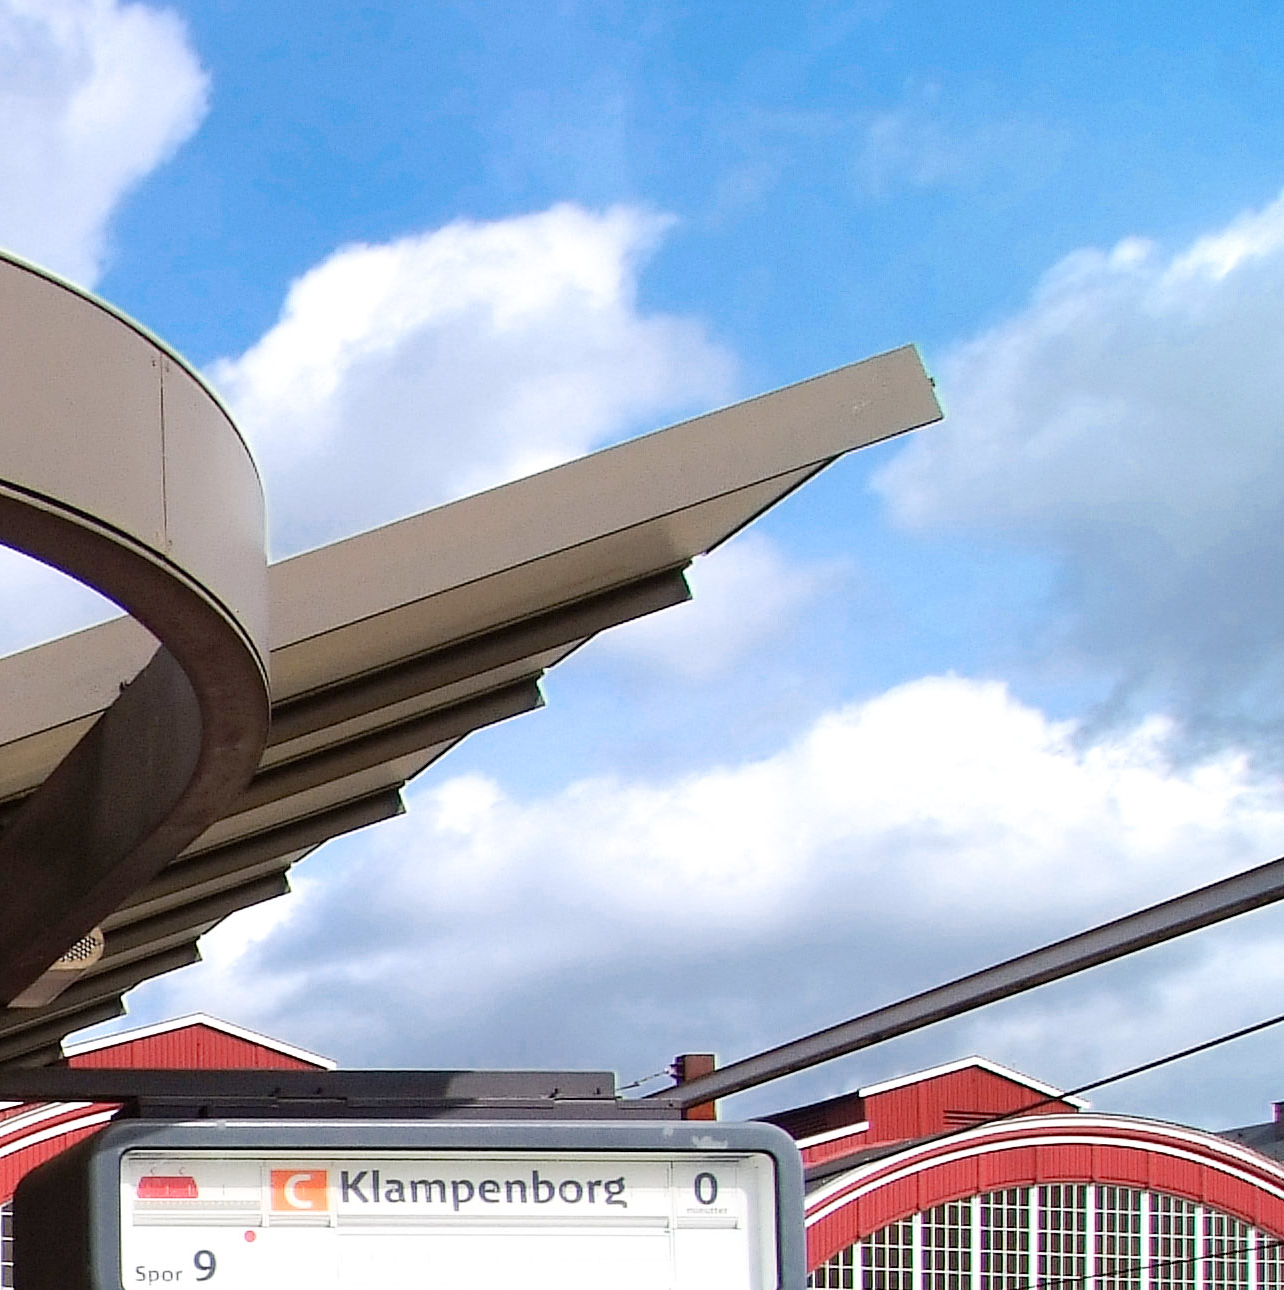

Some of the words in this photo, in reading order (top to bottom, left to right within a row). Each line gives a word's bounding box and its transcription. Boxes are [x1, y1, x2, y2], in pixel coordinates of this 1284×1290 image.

[284, 1172, 313, 1209] C
[340, 1169, 628, 1211] Klampenborg
[694, 1172, 718, 1205] 0
[135, 1265, 183, 1285] Spor
[193, 1249, 217, 1282] 9
